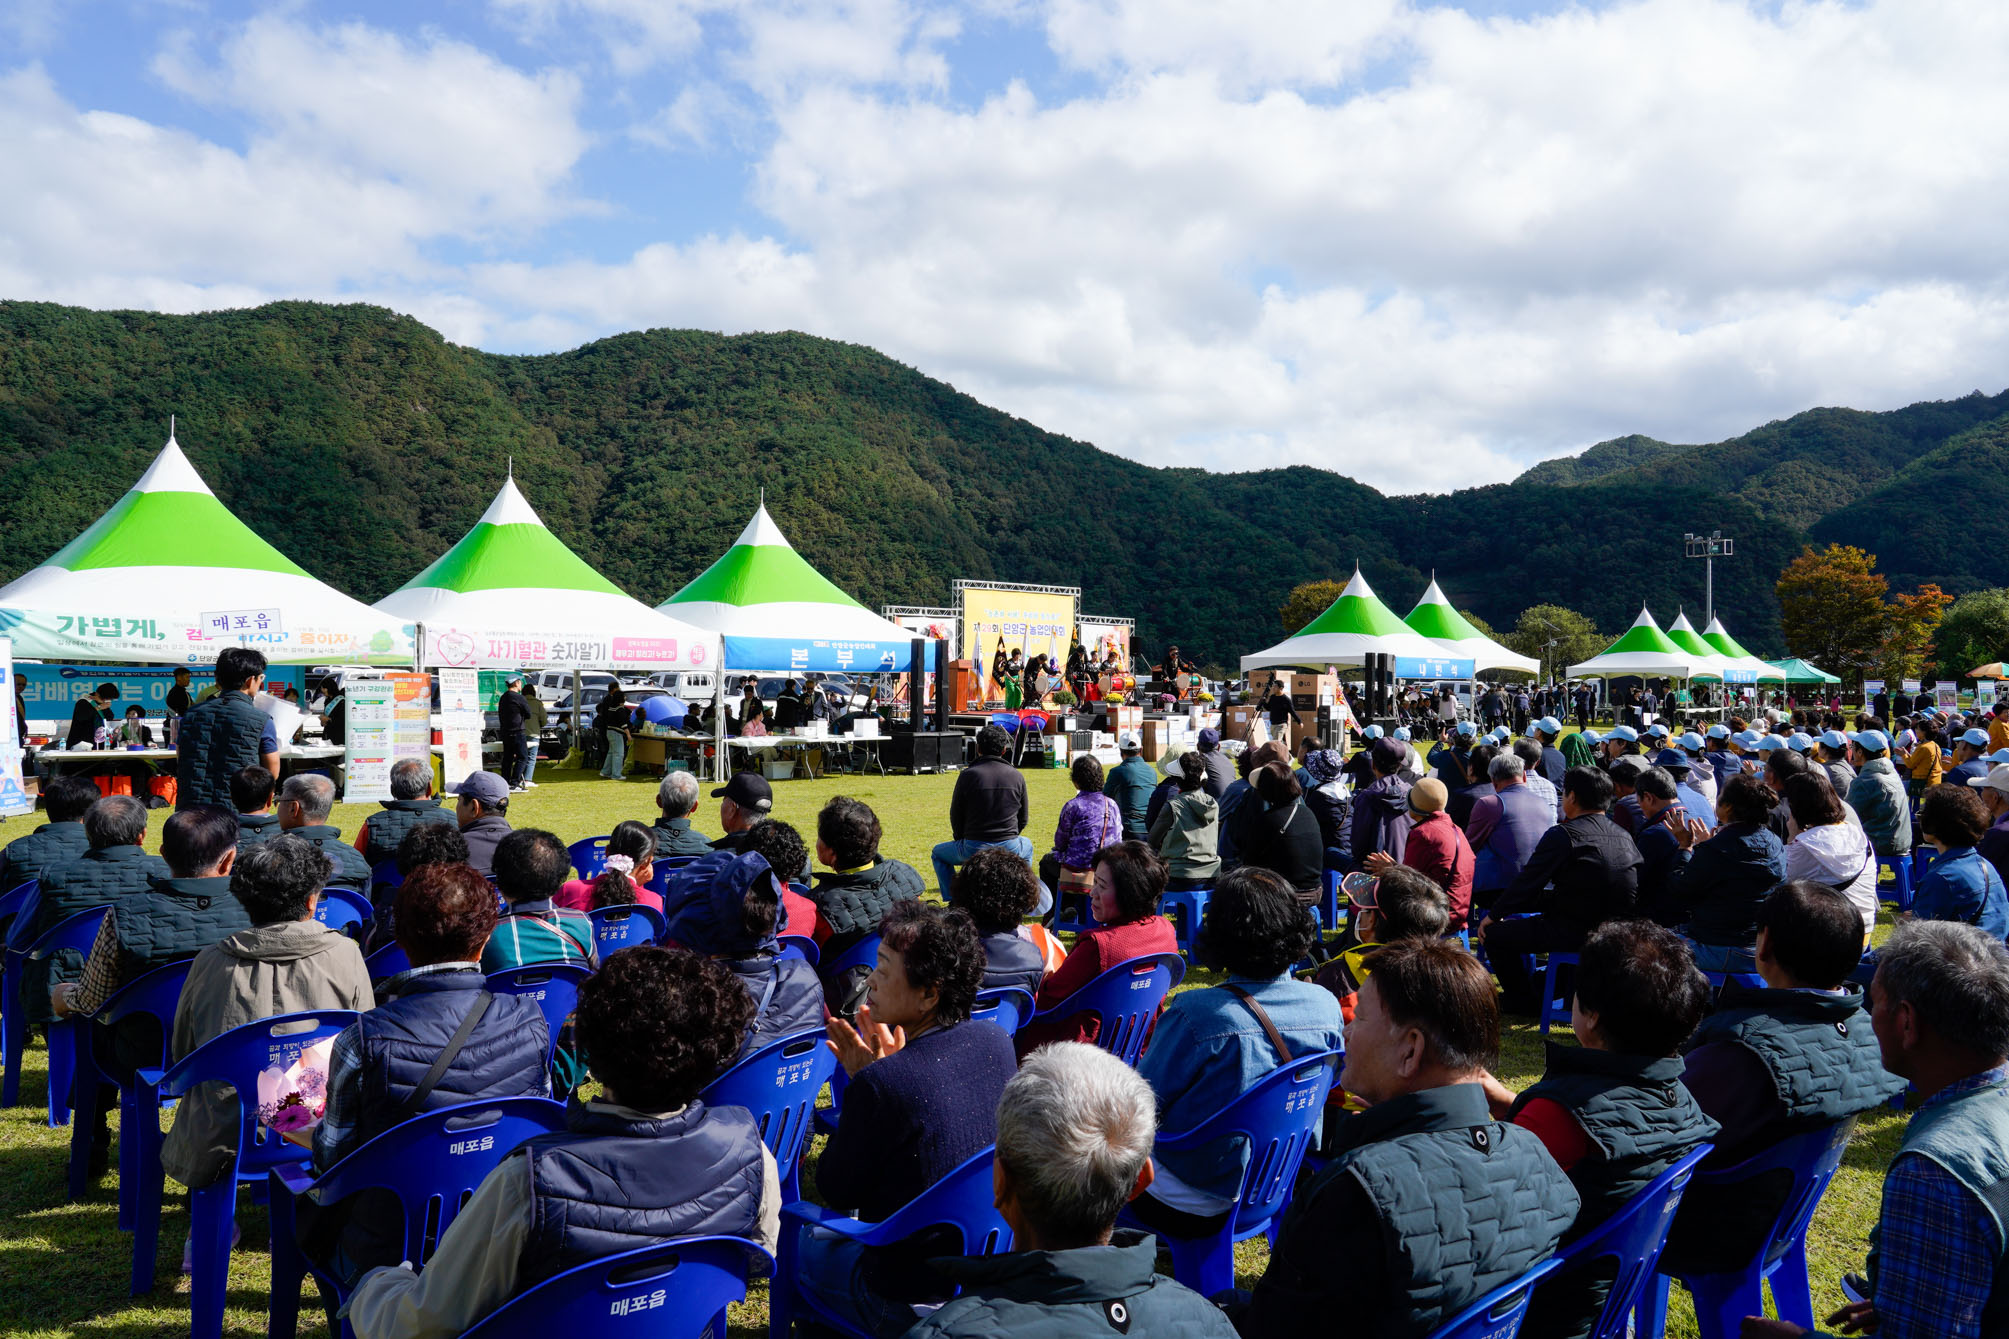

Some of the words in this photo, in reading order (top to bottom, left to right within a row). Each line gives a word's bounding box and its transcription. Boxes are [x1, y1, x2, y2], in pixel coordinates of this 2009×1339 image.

[56, 616, 166, 641] 가볍게,
[186, 628, 214, 641] 걷
[212, 613, 272, 632] 매포읍
[488, 639, 547, 660] 자기혈관
[551, 640, 606, 661] 숫자알기
[22, 681, 144, 702] 담배연는
[600, 930, 628, 941] 매포읍
[1130, 978, 1152, 990] 매포읍
[776, 1068, 811, 1088] 매포읍
[1285, 1093, 1315, 1114] 매포읍
[450, 1136, 495, 1155] 매포읍
[610, 1289, 667, 1316] 매포읍
